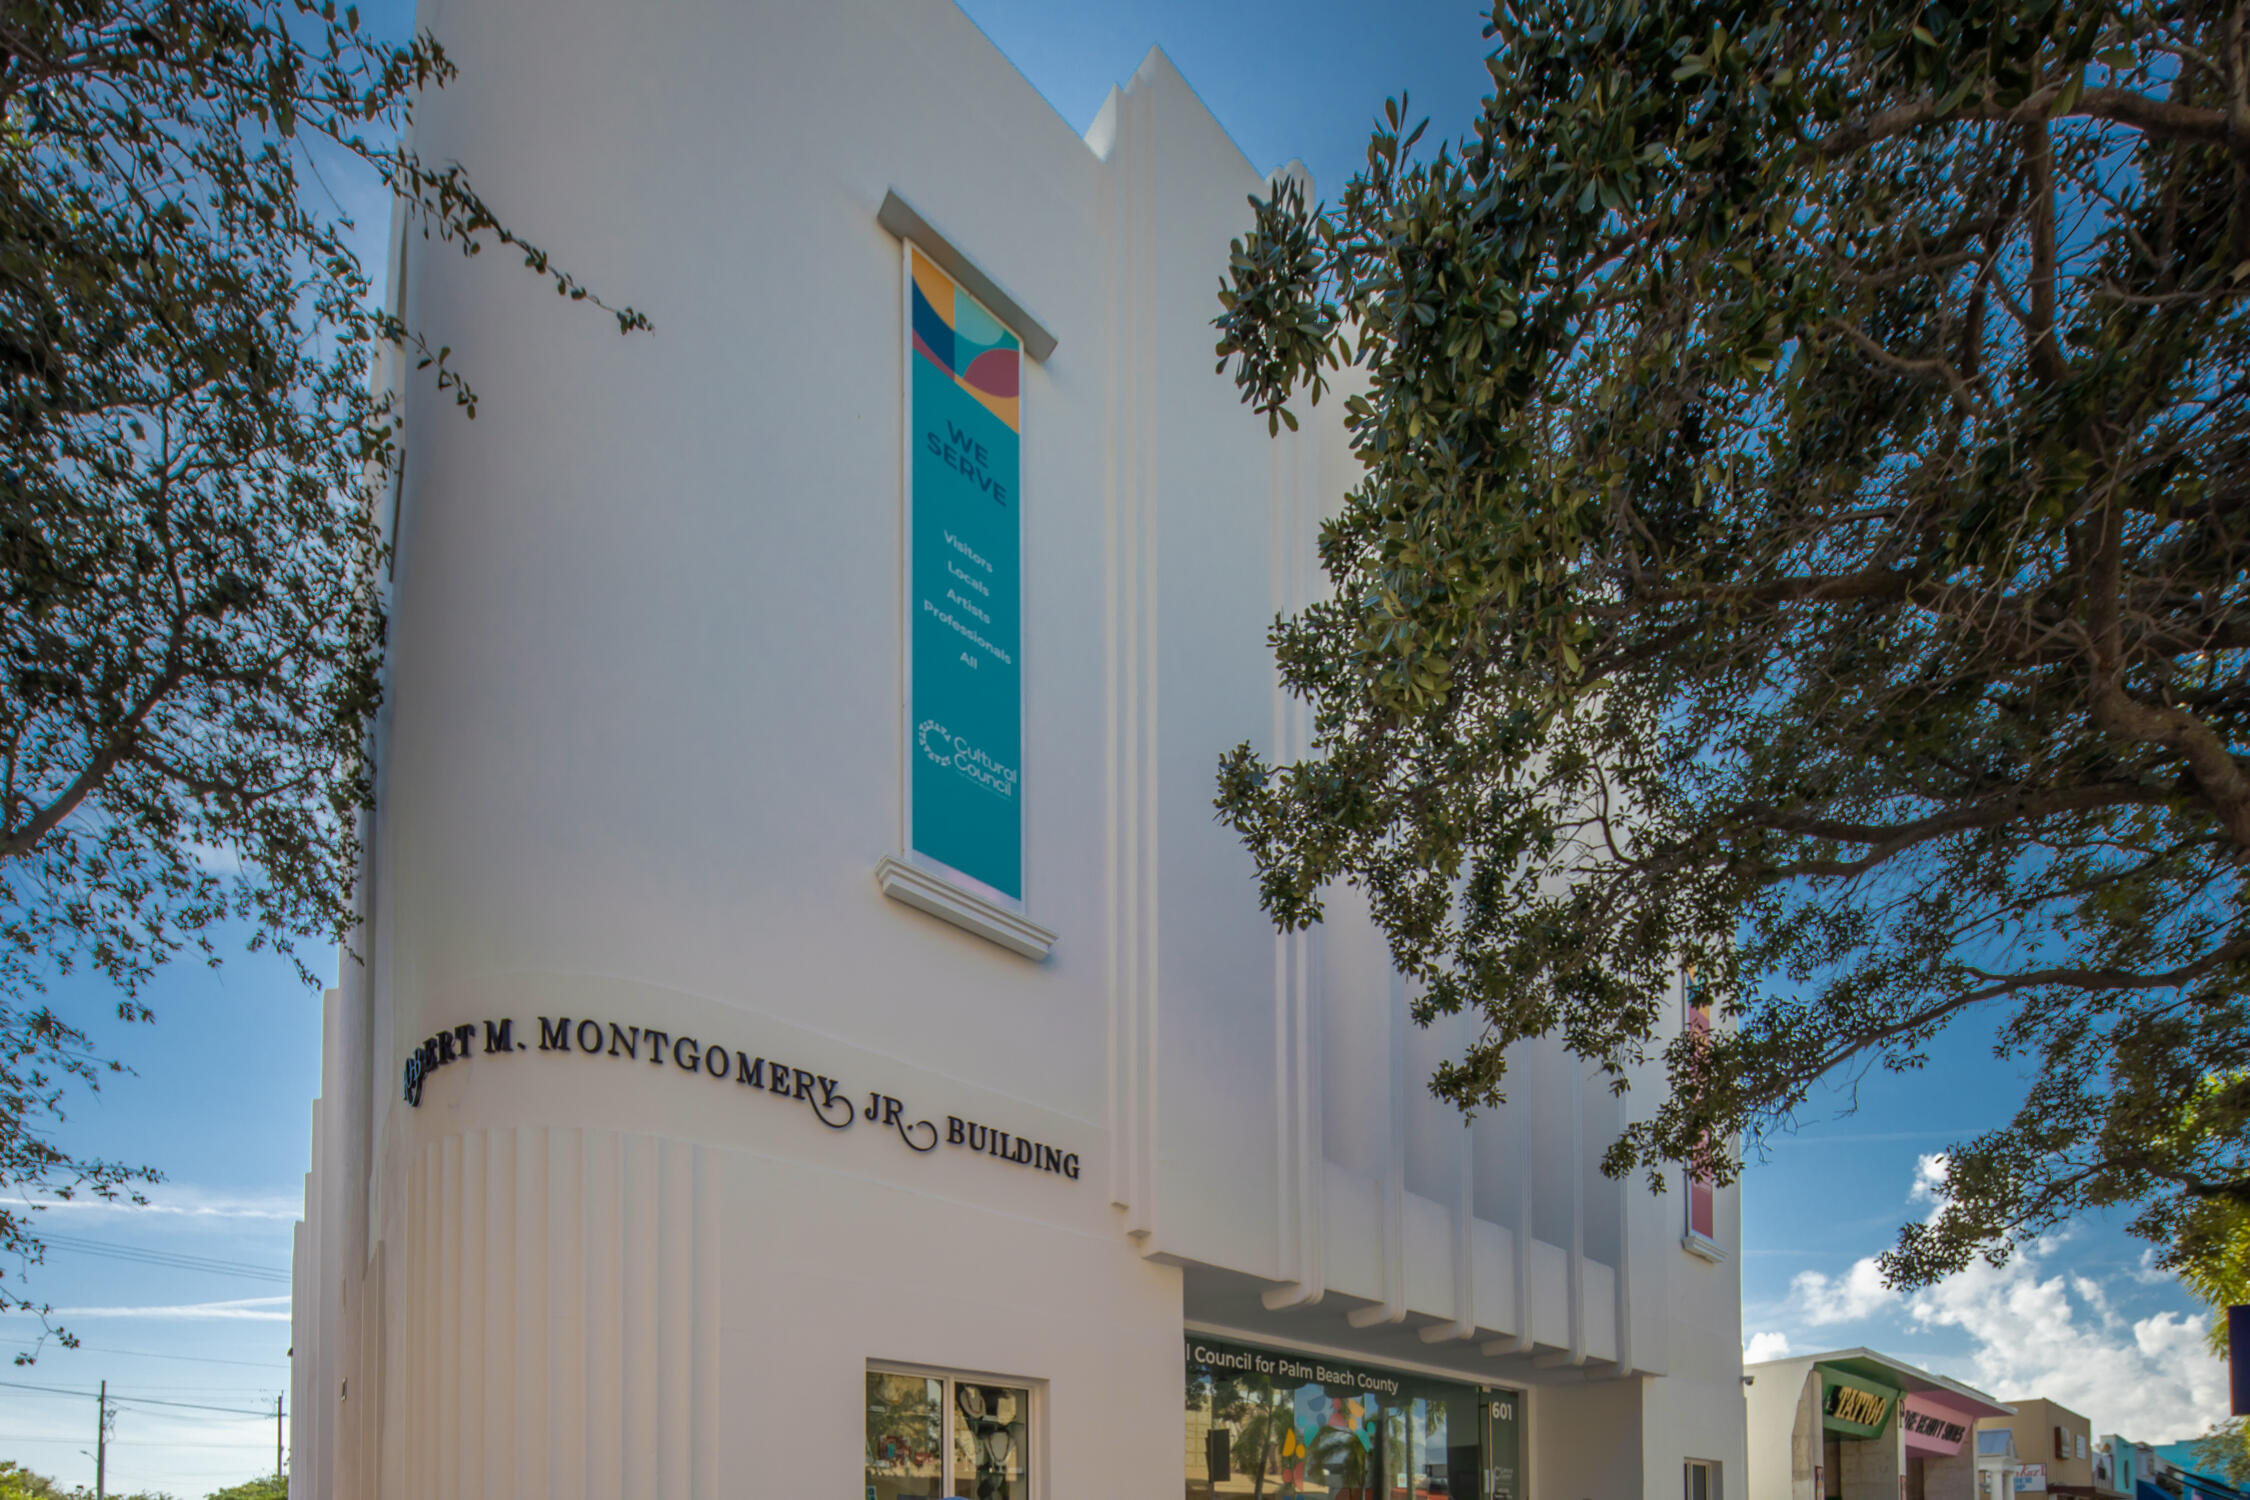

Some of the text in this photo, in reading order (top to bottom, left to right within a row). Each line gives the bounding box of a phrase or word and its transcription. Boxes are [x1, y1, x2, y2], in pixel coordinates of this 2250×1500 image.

[946, 418, 989, 470] WE
[926, 431, 1007, 508] SERVE
[943, 529, 993, 573] Visitors
[947, 560, 990, 597] Locals
[946, 587, 991, 625] Artists
[923, 599, 1012, 665] Professionals
[960, 651, 978, 670] All
[953, 736, 1017, 784] Cultural
[953, 752, 1012, 797] Council
[483, 1018, 526, 1053] M.
[537, 1016, 854, 1129] MONTGOMERY
[864, 1092, 938, 1152] JR.
[946, 1115, 1080, 1180] BUILDING
[1194, 1346, 1252, 1371] Council
[1255, 1355, 1275, 1374] for
[1279, 1359, 1313, 1380] Palm
[1316, 1365, 1355, 1386] Beach
[1357, 1372, 1399, 1396] County
[1491, 1401, 1513, 1421] 601
[1833, 1386, 1888, 1427] TATTOO
